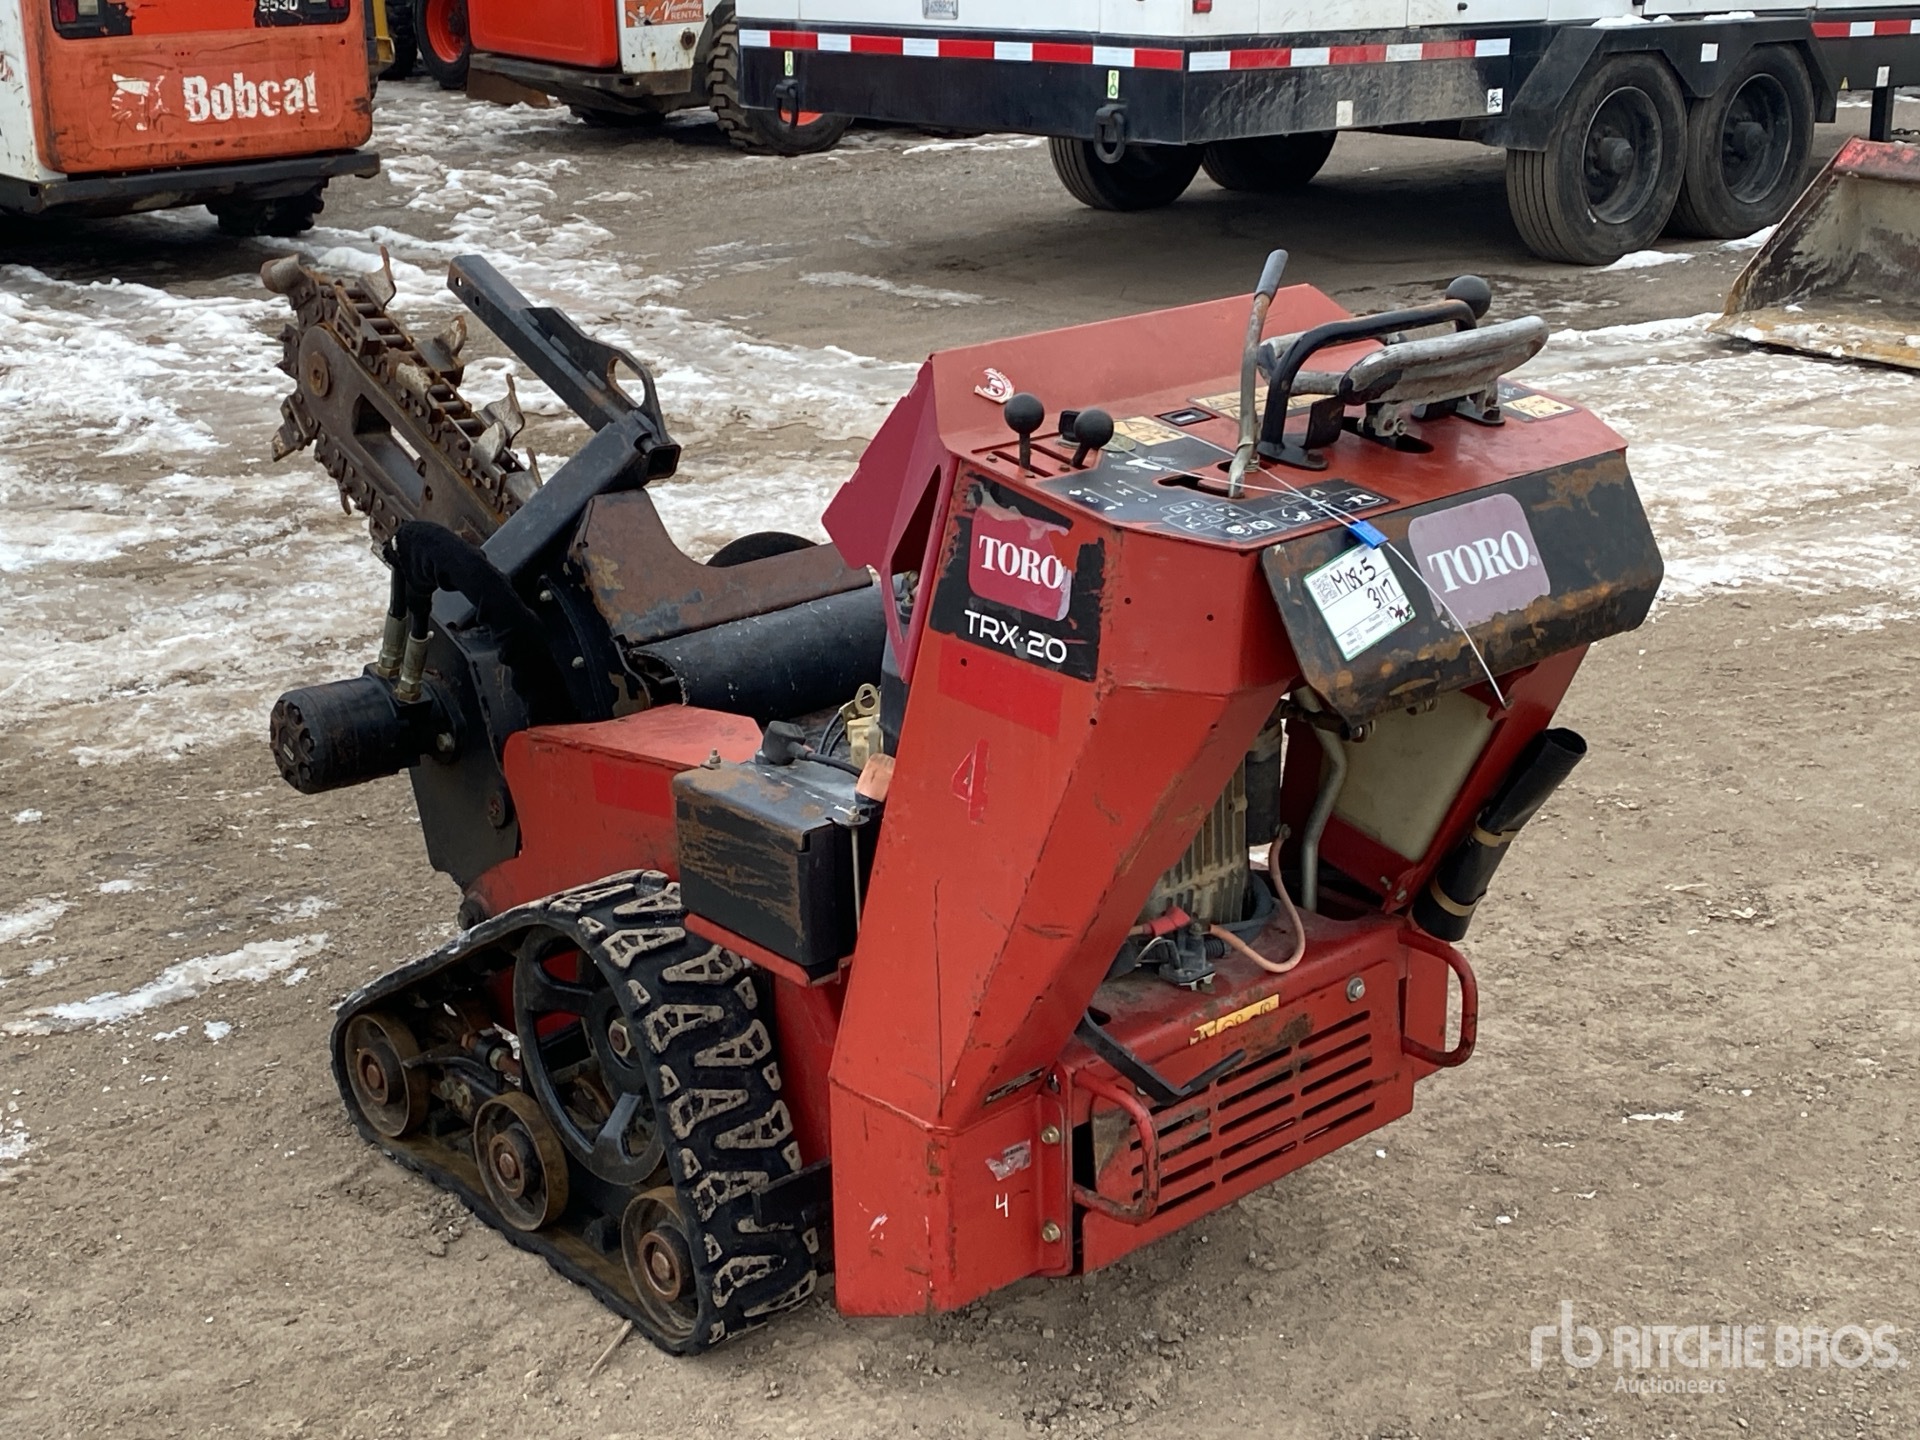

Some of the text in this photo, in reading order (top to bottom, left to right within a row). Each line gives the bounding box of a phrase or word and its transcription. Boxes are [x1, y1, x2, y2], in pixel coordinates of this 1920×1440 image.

[183, 71, 319, 122] Bobcat
[978, 535, 1064, 589] TORO
[995, 1192, 1009, 1218] 4
